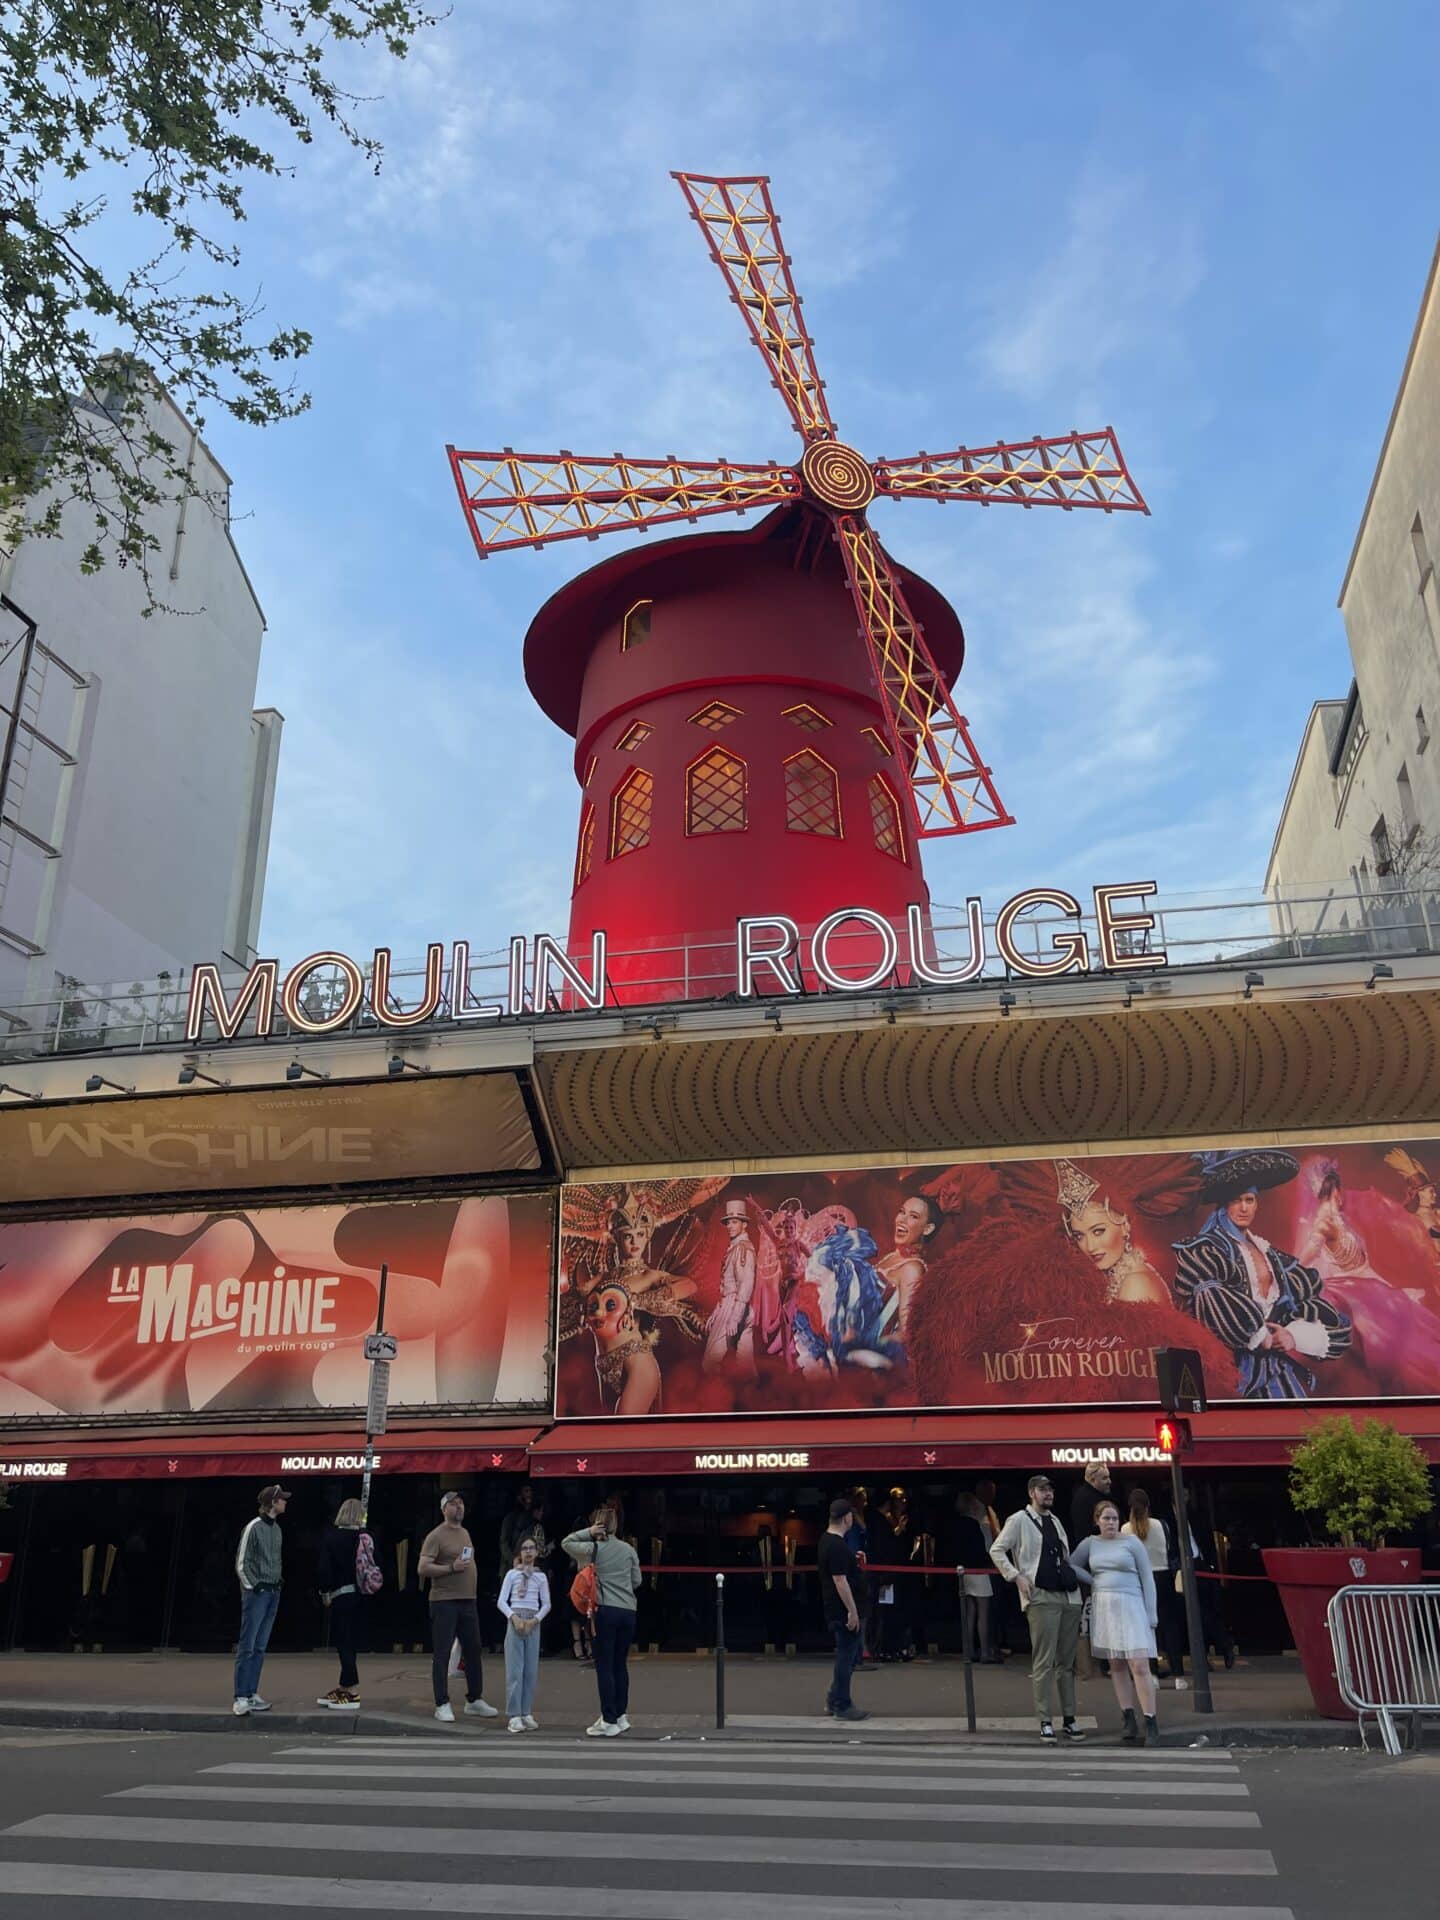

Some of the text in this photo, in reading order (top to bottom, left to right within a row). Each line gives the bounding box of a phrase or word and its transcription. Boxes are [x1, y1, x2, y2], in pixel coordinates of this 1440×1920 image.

[186, 880, 1166, 1041] MOULIN ROUGE
[110, 1267, 139, 1293] LA
[1008, 1317, 1126, 1353] Forever
[237, 1341, 336, 1353] du moulin rouge
[983, 1351, 1073, 1384] MOULIN
[695, 1452, 809, 1468] MOULIN ROUGE
[1051, 1446, 1173, 1462] MOULIN ROUG
[0, 1462, 68, 1476] LIN ROUGE
[281, 1456, 381, 1469] MOULIN ROUE
